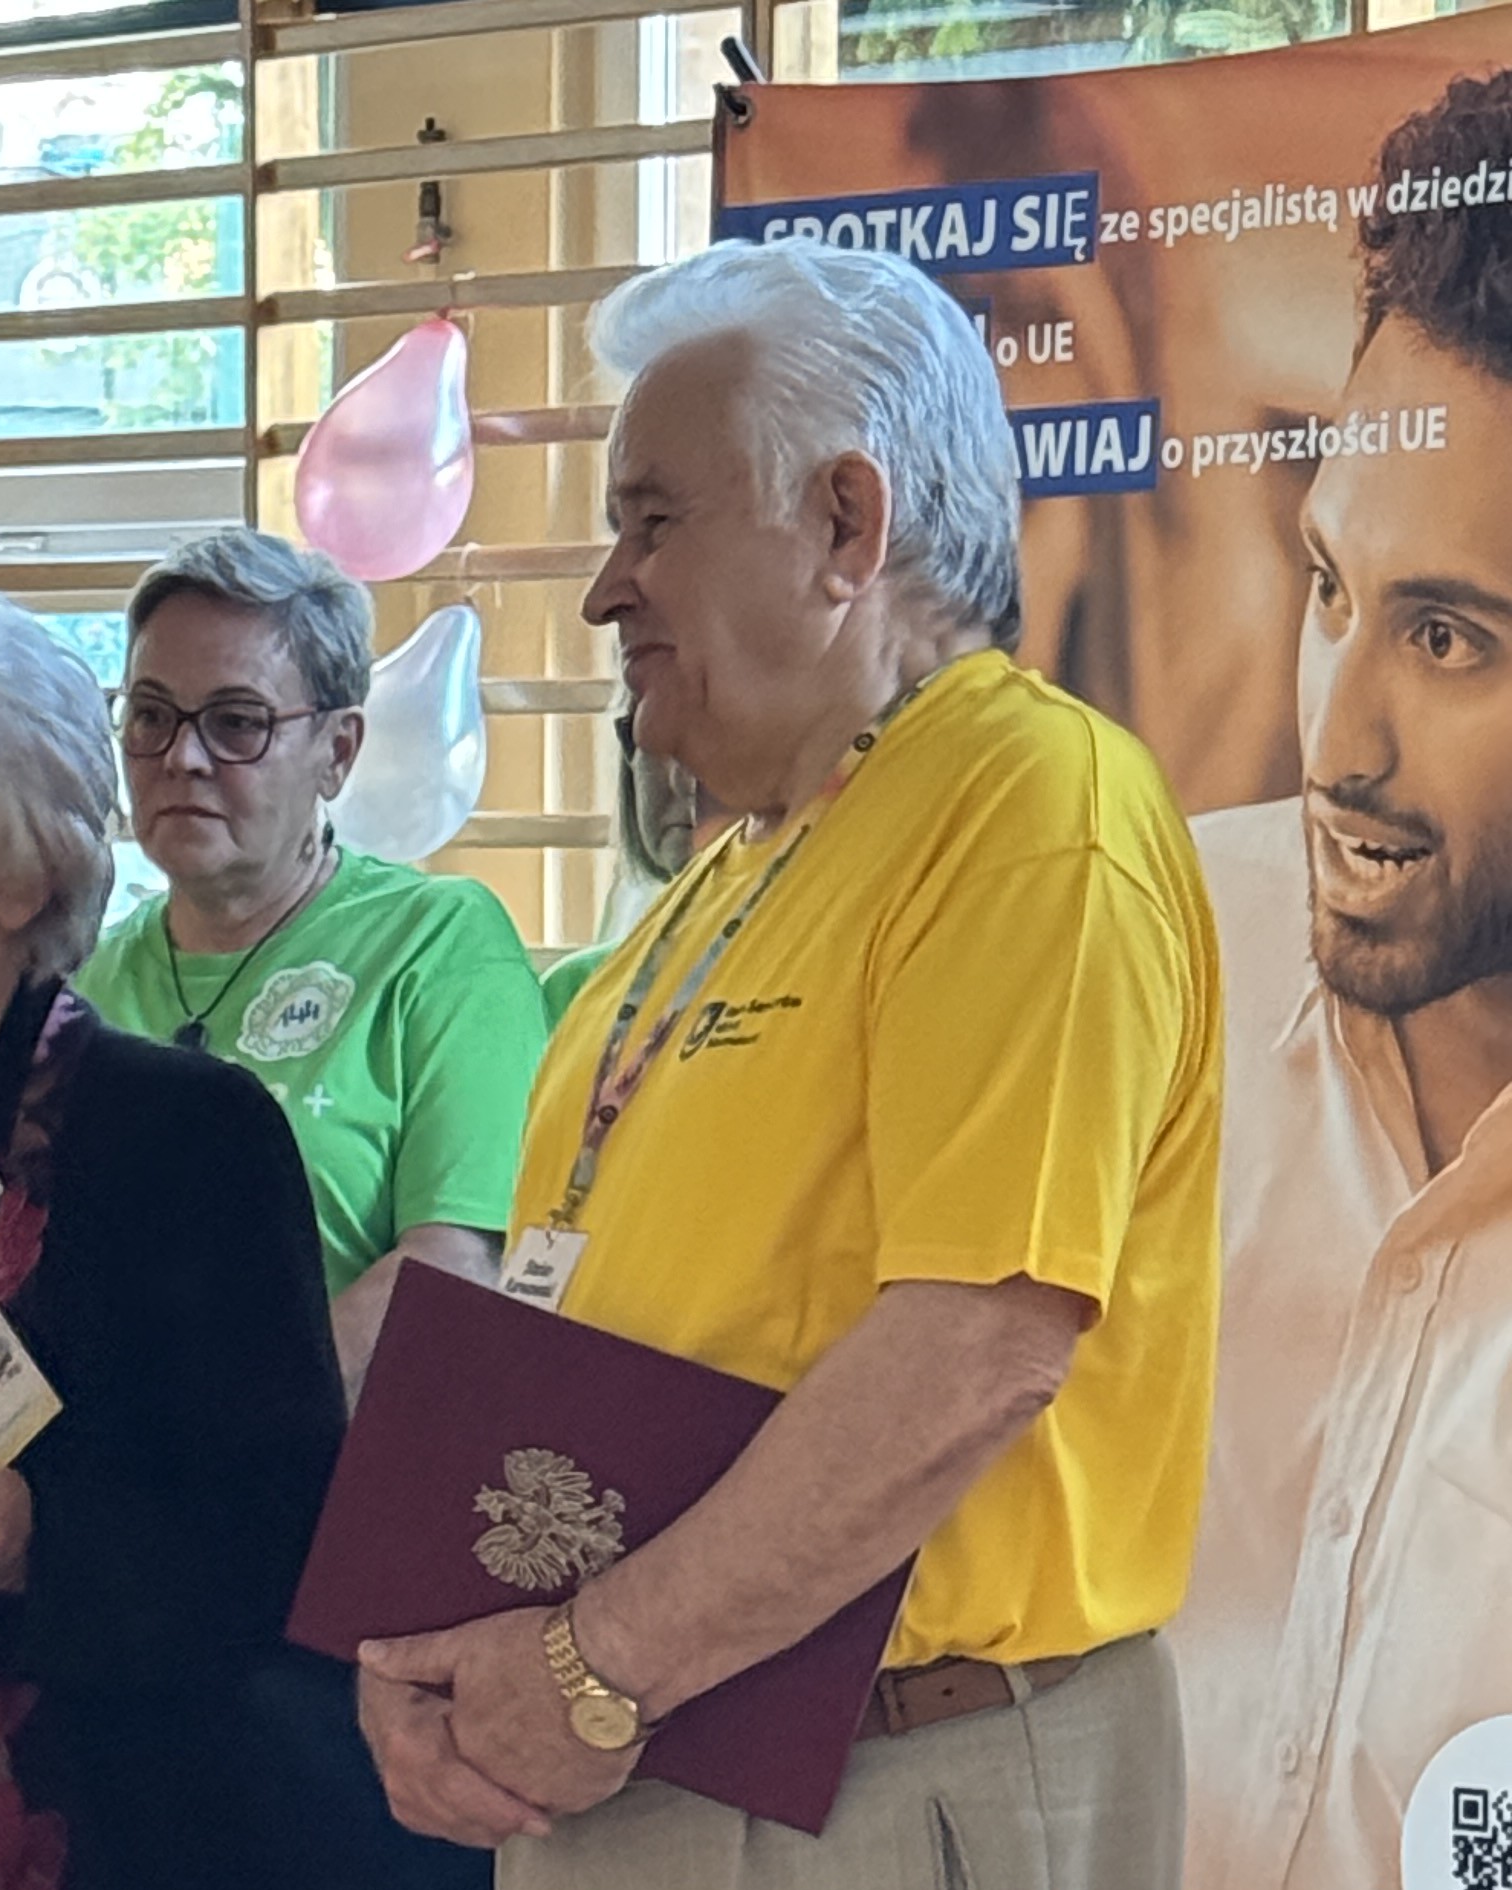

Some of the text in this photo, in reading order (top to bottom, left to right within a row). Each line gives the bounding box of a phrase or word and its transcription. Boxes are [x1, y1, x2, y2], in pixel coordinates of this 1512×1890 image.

[1010, 190, 1089, 262] SIĘ
[1099, 209, 1140, 244] ze
[1147, 183, 1339, 248] specjalistą
[1346, 183, 1379, 218] w
[996, 336, 1018, 367] o
[1027, 321, 1075, 364] UE
[1014, 405, 1448, 479] WIAJ o przyszłości UE
